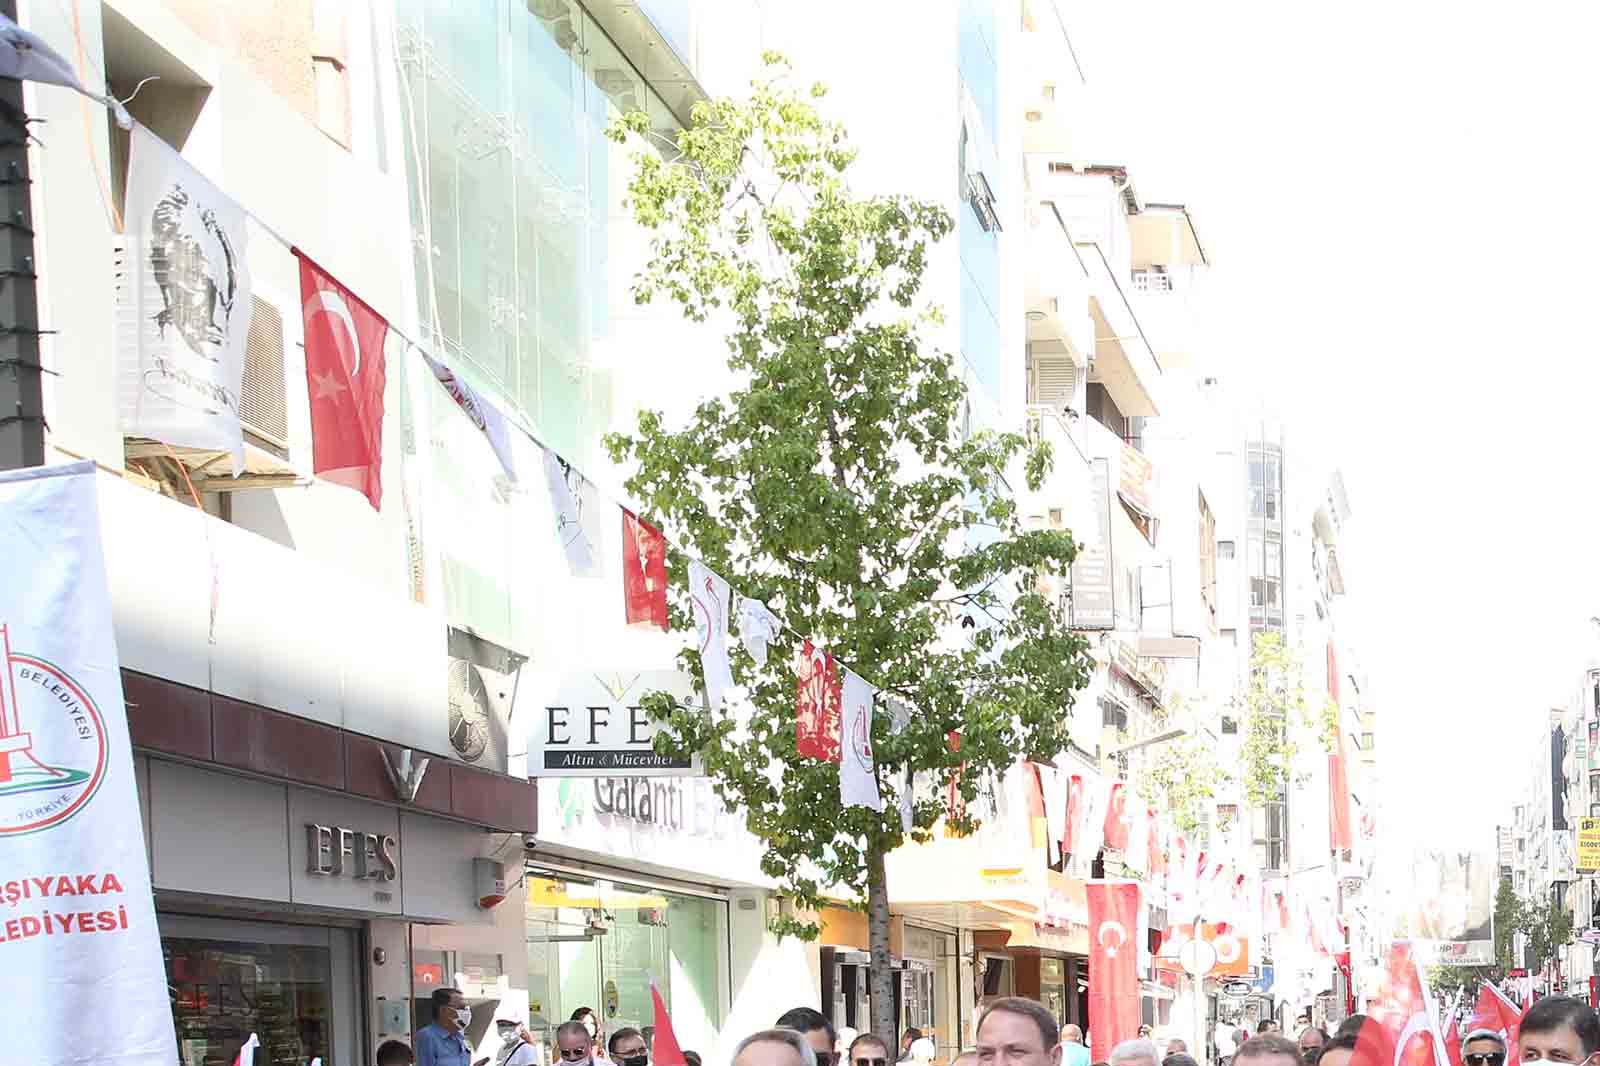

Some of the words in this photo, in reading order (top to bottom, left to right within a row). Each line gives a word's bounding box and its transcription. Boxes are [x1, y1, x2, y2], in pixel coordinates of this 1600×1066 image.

[19, 667, 94, 740] BELEDİYESİ
[562, 753, 595, 766] Altın
[18, 793, 73, 820] TÜRKİYE
[305, 823, 397, 881] EFES
